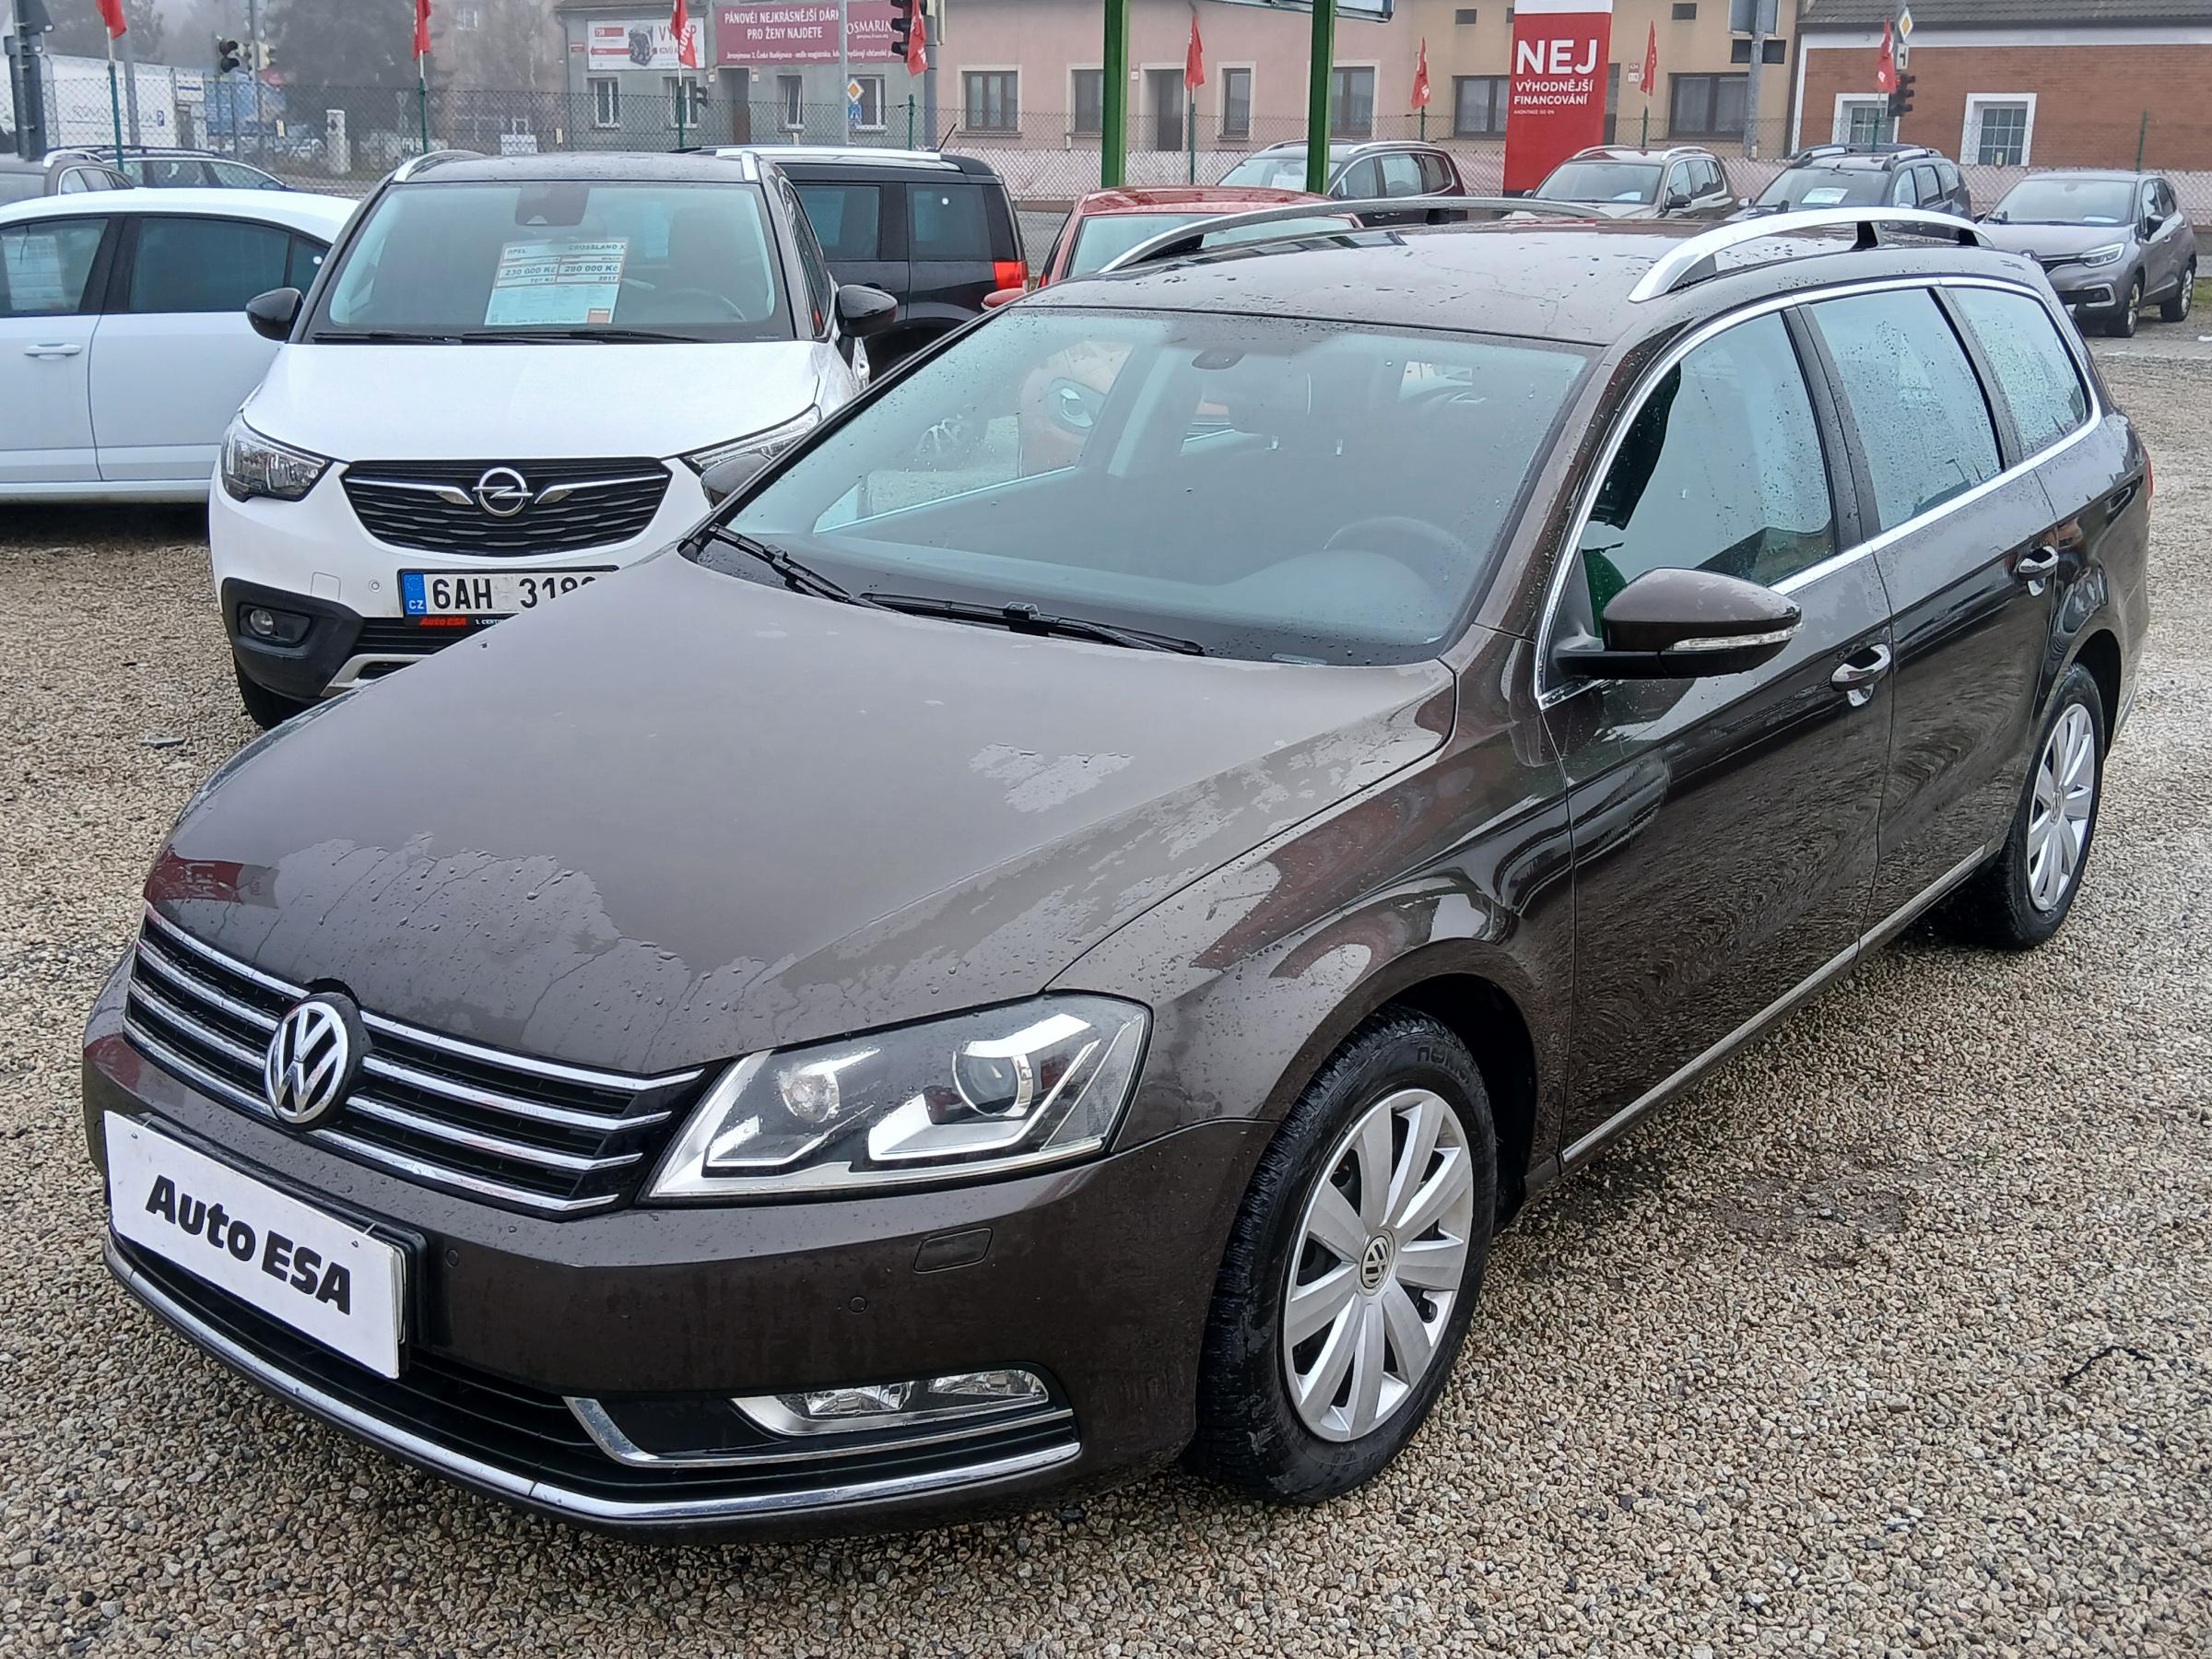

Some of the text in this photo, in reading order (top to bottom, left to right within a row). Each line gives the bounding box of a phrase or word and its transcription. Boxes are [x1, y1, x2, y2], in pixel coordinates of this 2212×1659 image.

[724, 10, 758, 24] PÁNOVÉ!
[759, 7, 818, 23] NEJKRÁSNĚJŠÍ
[747, 26, 823, 40] PRO ŽENY NAJDETE
[847, 20, 900, 34] OSMARIN
[1516, 39, 1598, 75] NEJ
[1516, 79, 1594, 92] VÝHODNĚJŠÍ
[1513, 94, 1588, 105] FINANCOVÁNÍ
[432, 576, 597, 609] 6AH 318
[408, 599, 425, 609] CZ
[419, 617, 447, 626] Auto
[145, 1174, 351, 1316] Auto ESA
